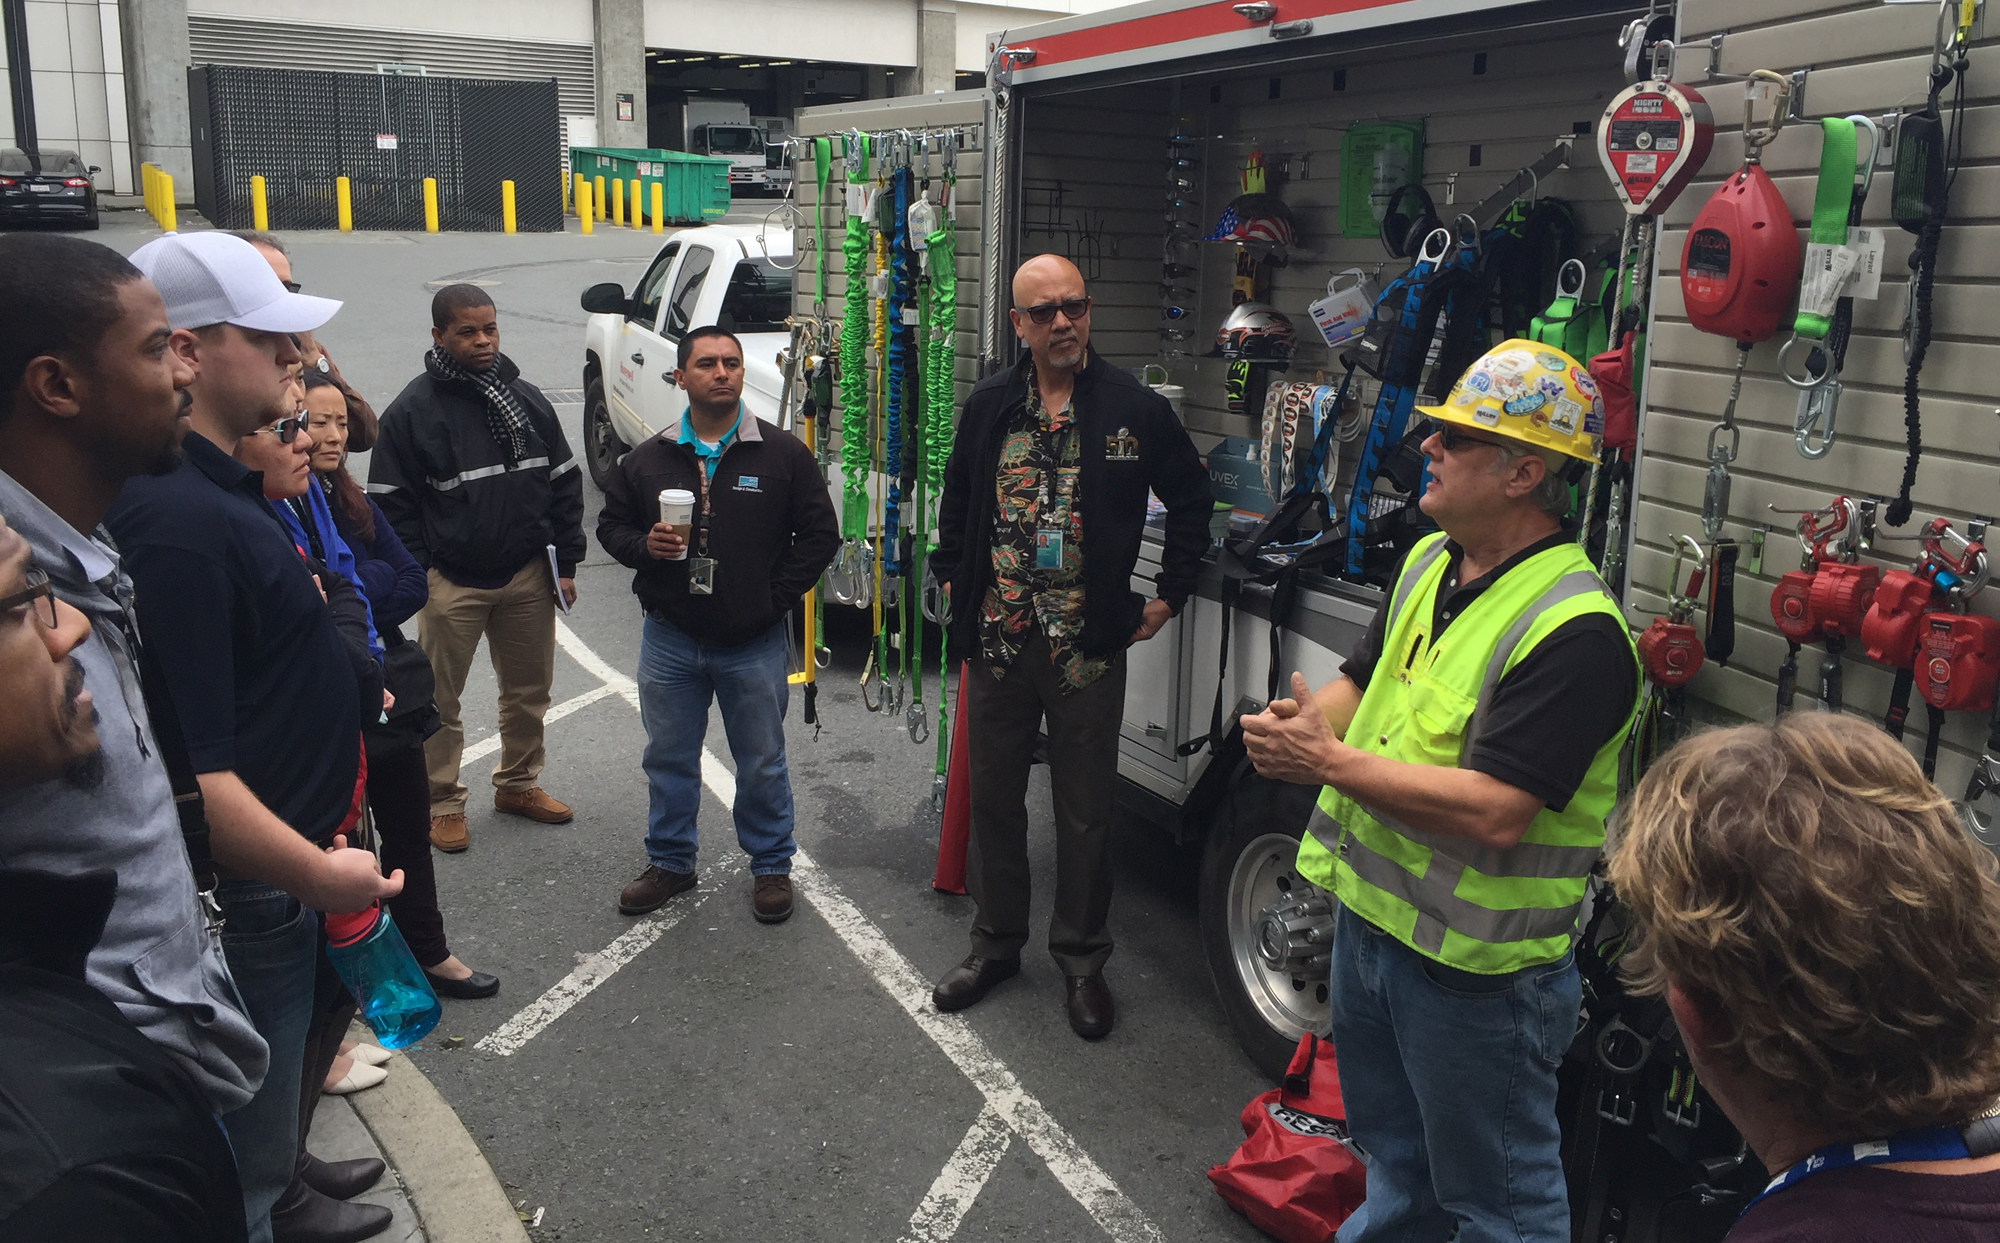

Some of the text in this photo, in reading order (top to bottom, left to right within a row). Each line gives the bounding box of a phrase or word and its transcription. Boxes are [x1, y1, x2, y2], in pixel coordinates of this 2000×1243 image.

[1633, 99, 1663, 107] MIGHTY
[1627, 176, 1652, 184] MILLER
[1694, 234, 1728, 250] FALCON
[1867, 250, 1877, 274] Lanyard
[1319, 319, 1333, 328] First
[1333, 314, 1343, 322] Aid
[1468, 374, 1490, 393] CBI
[1209, 470, 1240, 486] UVEX
